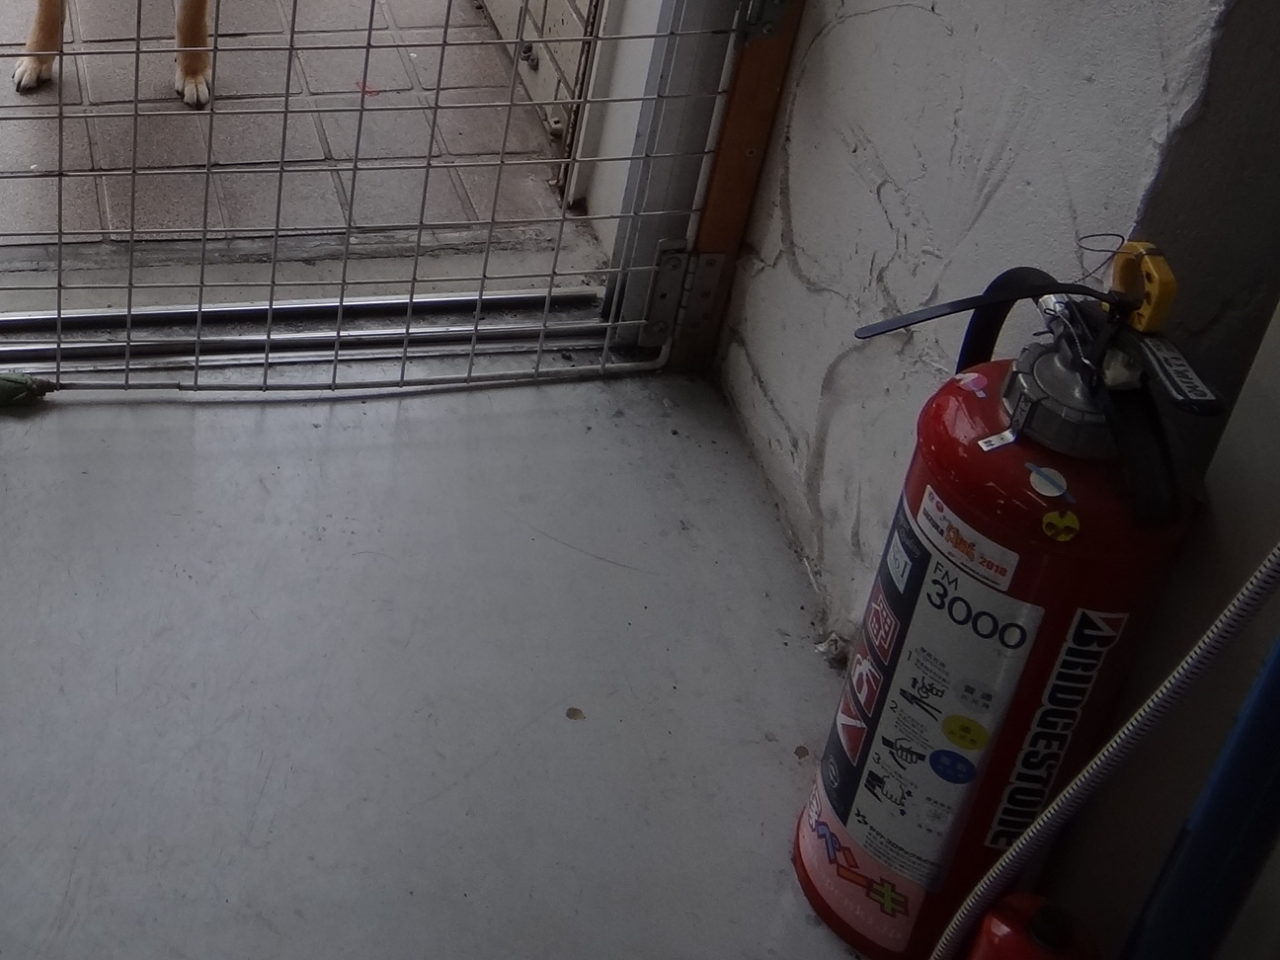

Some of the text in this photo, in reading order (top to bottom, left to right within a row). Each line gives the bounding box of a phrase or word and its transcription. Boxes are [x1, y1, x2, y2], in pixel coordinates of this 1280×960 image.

[933, 561, 958, 591] FM
[979, 555, 1008, 577] 2018
[926, 578, 1027, 649] 3000
